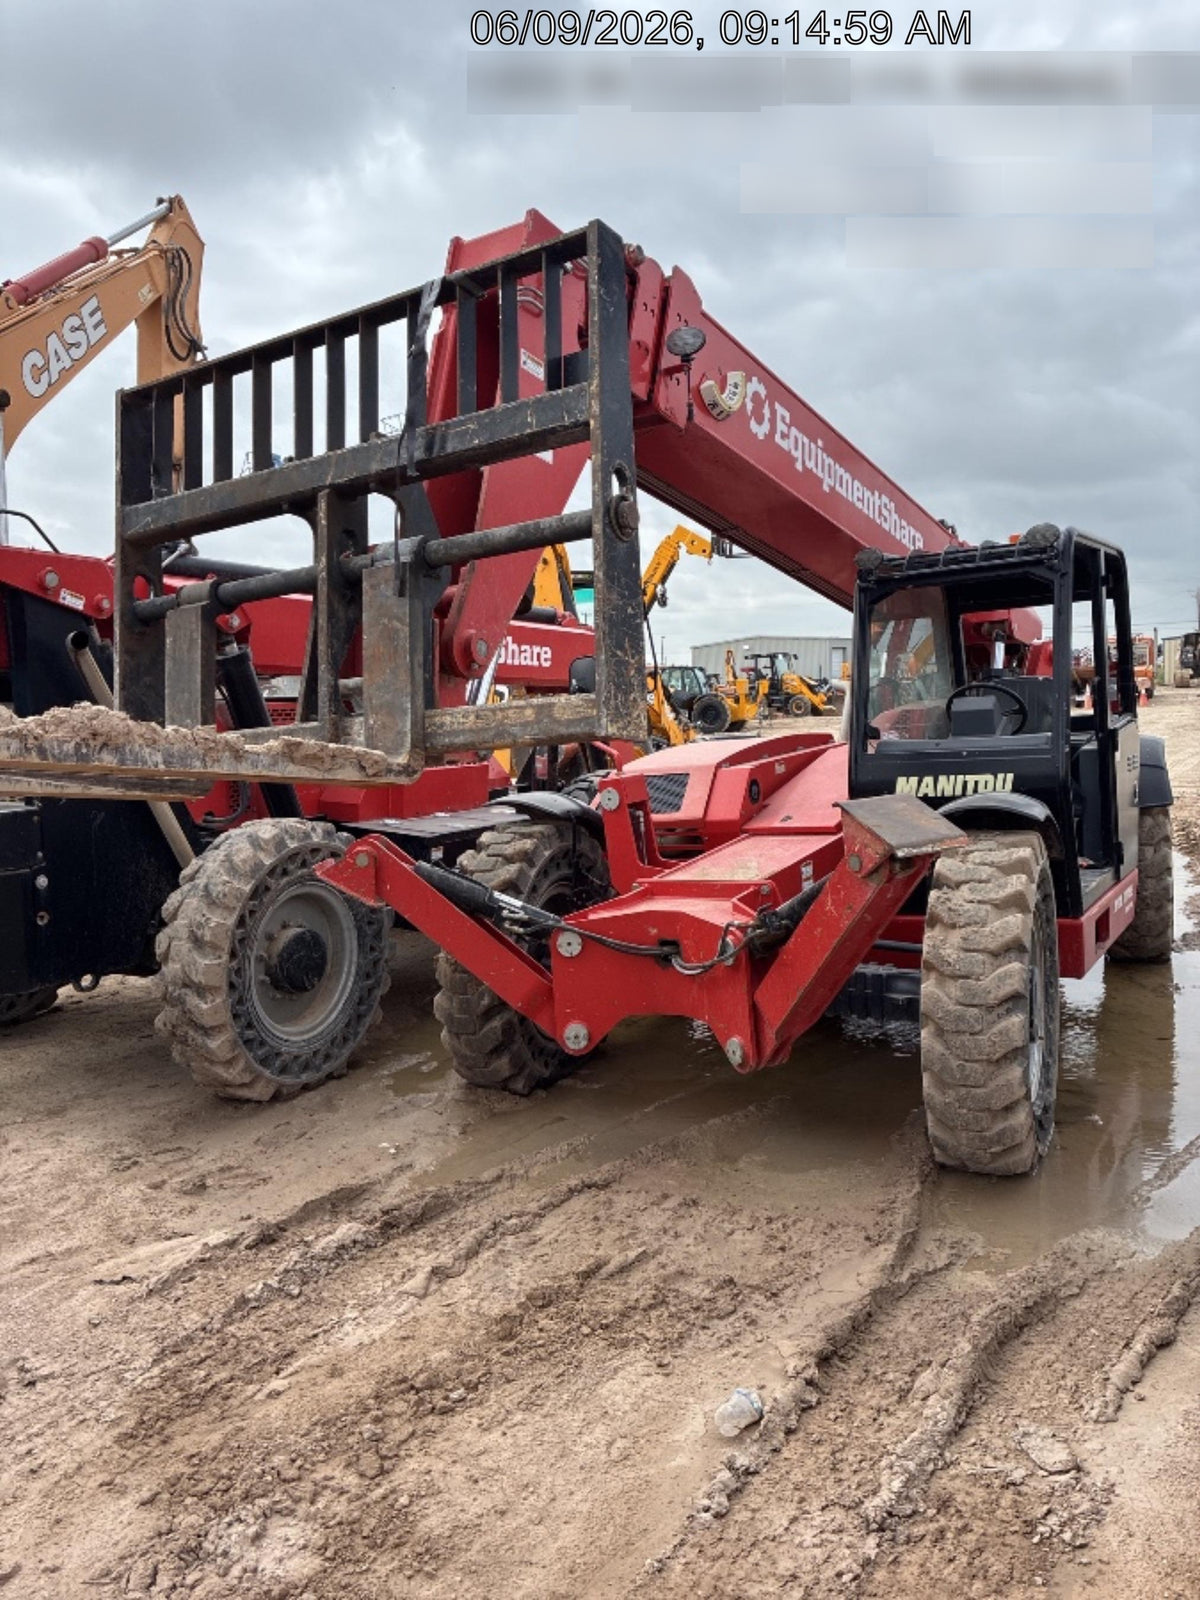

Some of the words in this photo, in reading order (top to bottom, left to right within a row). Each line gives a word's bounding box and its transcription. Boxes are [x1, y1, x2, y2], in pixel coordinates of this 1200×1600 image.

[21, 293, 108, 399] CASE
[774, 401, 924, 550] EquipmentShare
[895, 772, 1014, 798] MANITOU
